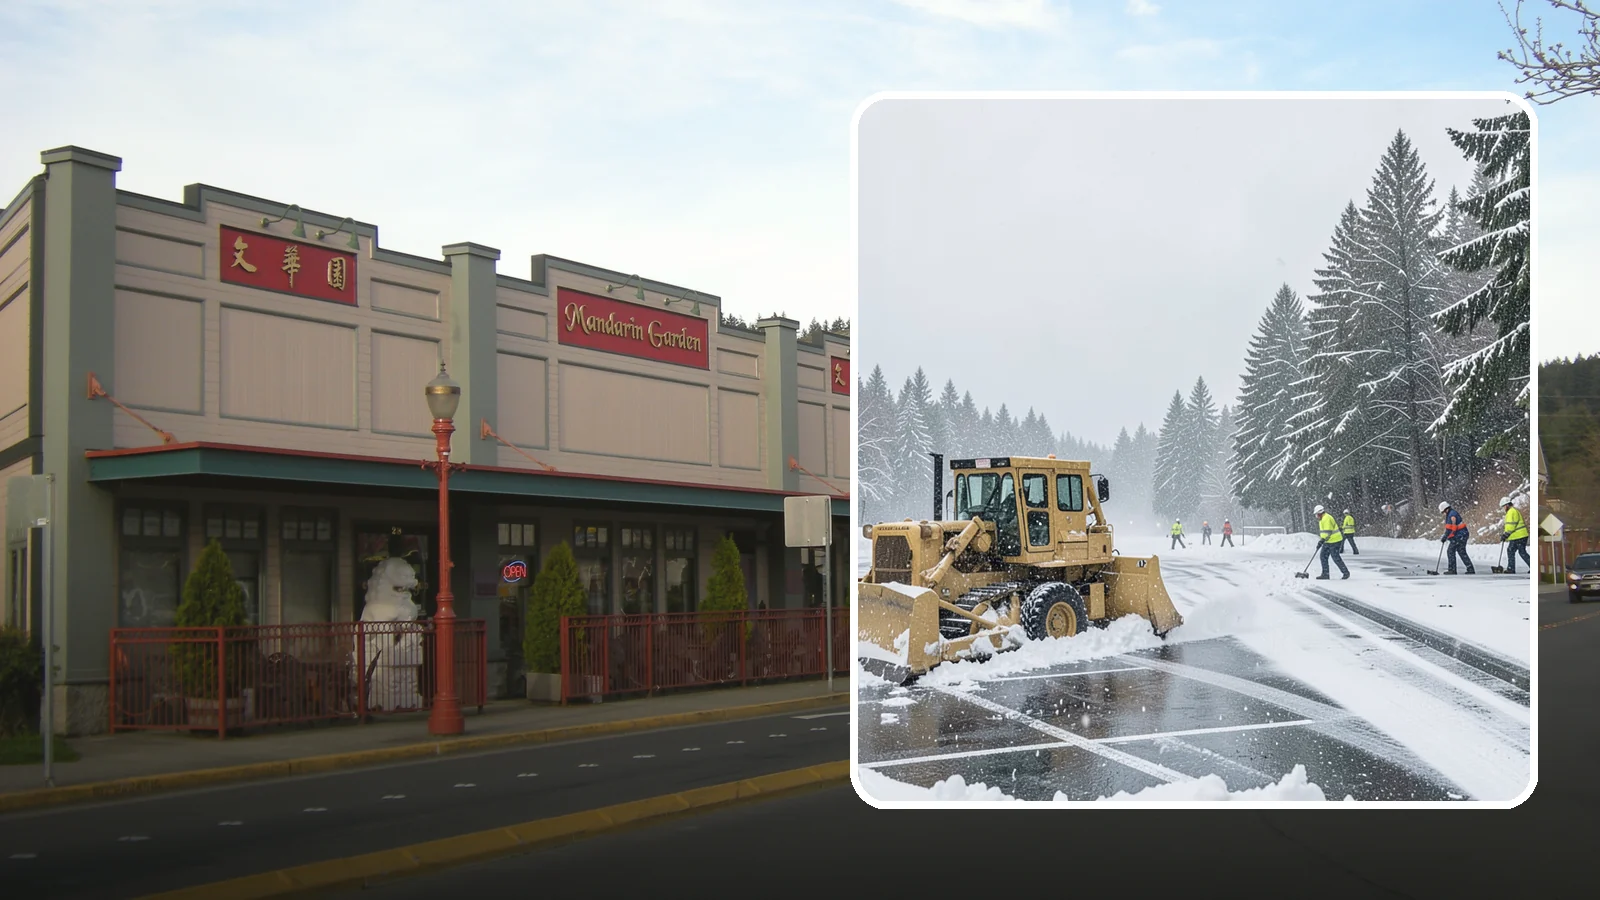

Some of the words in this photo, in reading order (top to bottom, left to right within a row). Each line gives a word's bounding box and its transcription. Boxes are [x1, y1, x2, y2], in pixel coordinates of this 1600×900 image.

[230, 235, 346, 291] 文華園
[564, 302, 644, 341] Mandarin
[648, 320, 701, 352] Garden
[503, 565, 527, 578] OPEN
